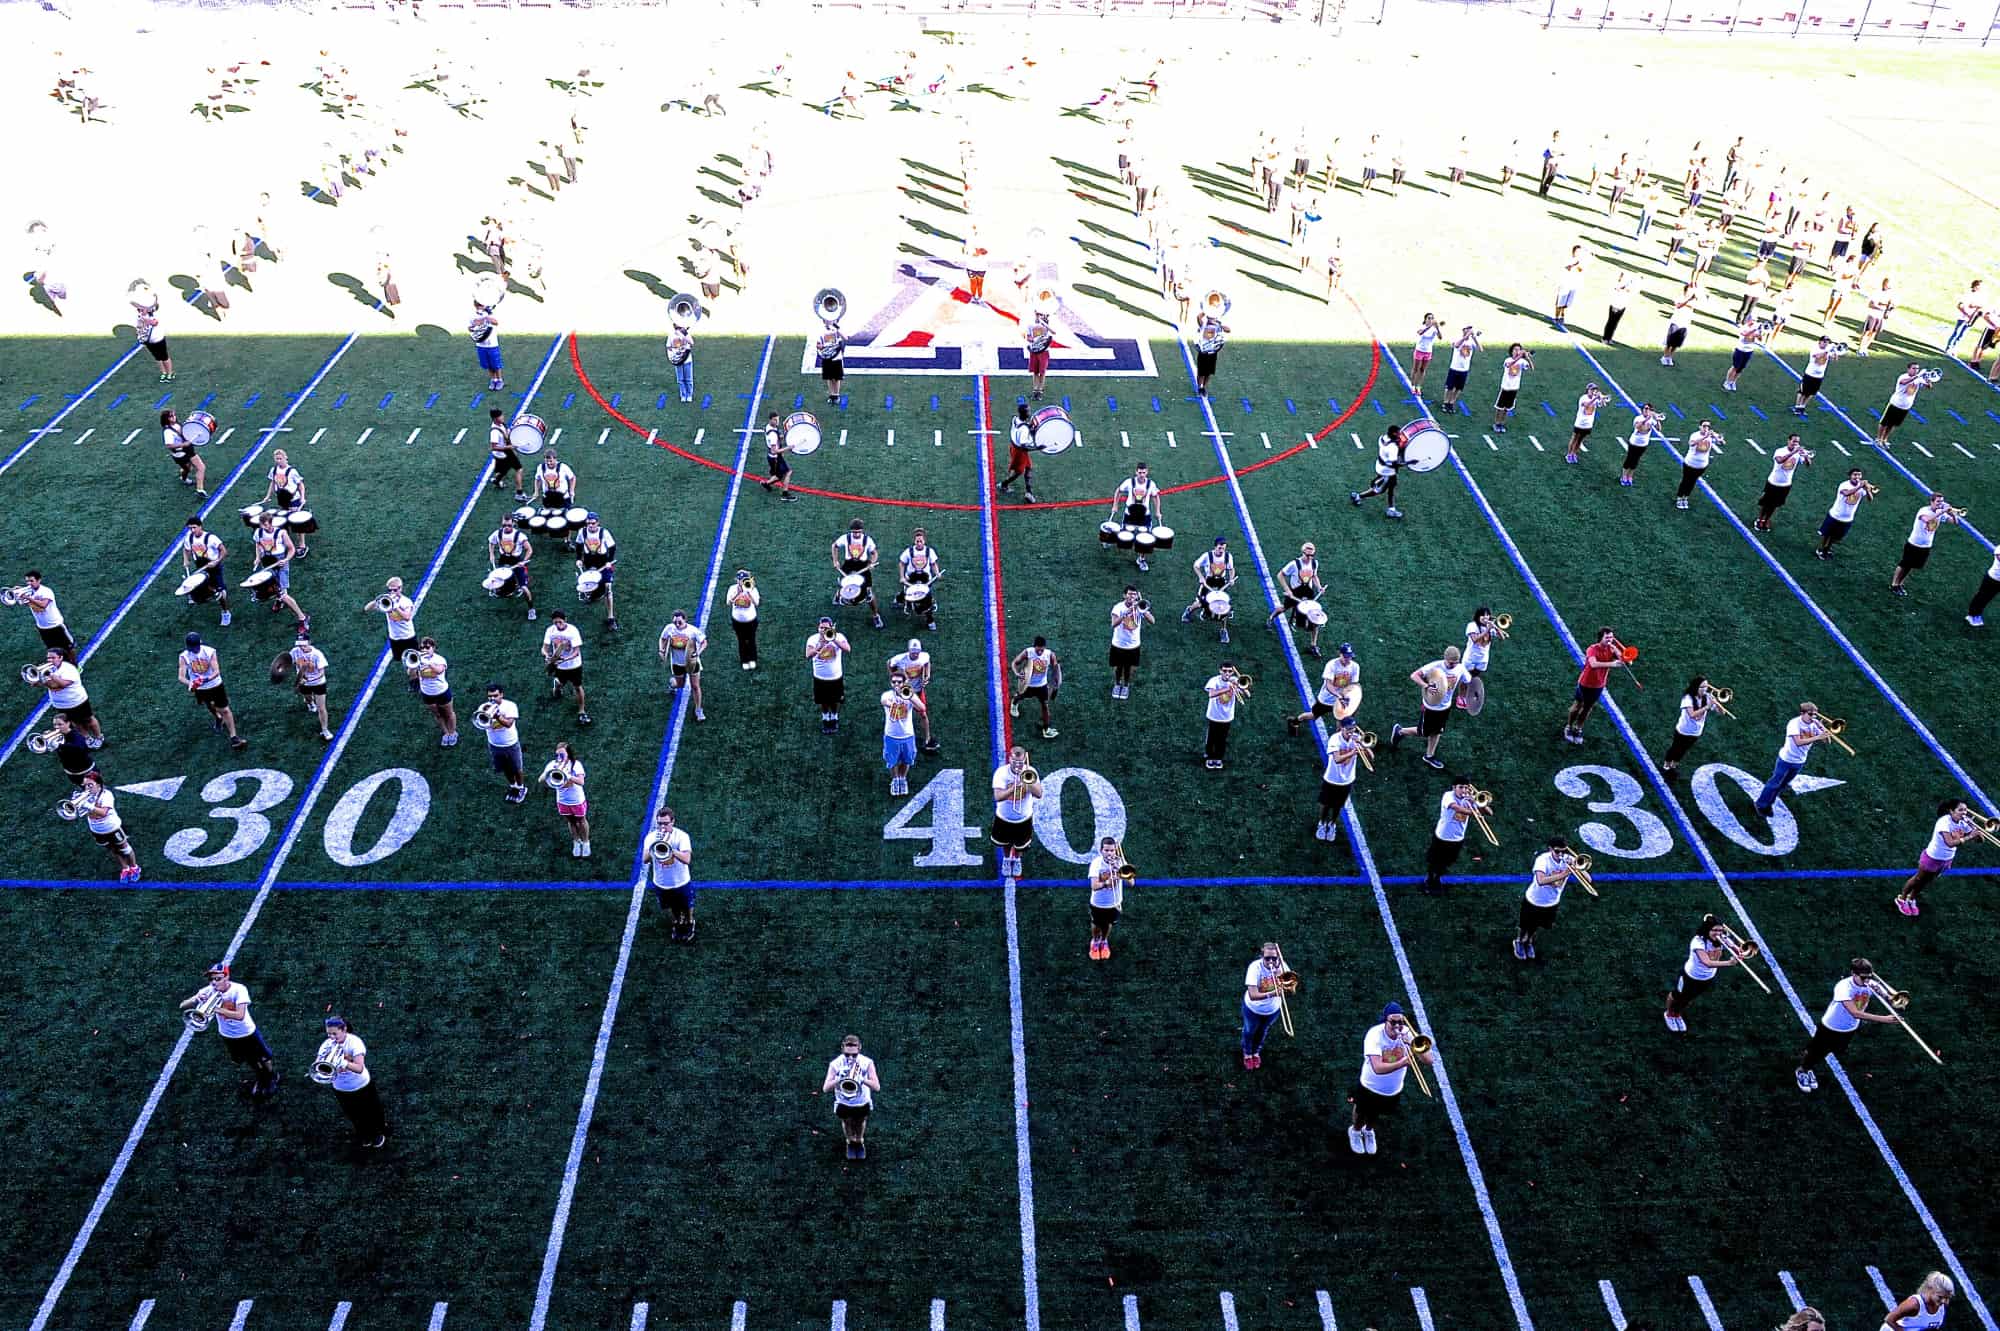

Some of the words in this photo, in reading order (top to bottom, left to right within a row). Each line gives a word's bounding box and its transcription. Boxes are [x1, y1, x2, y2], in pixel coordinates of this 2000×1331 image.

[163, 767, 431, 868] 30
[882, 766, 1127, 867] 40
[1553, 762, 1800, 860] 30
